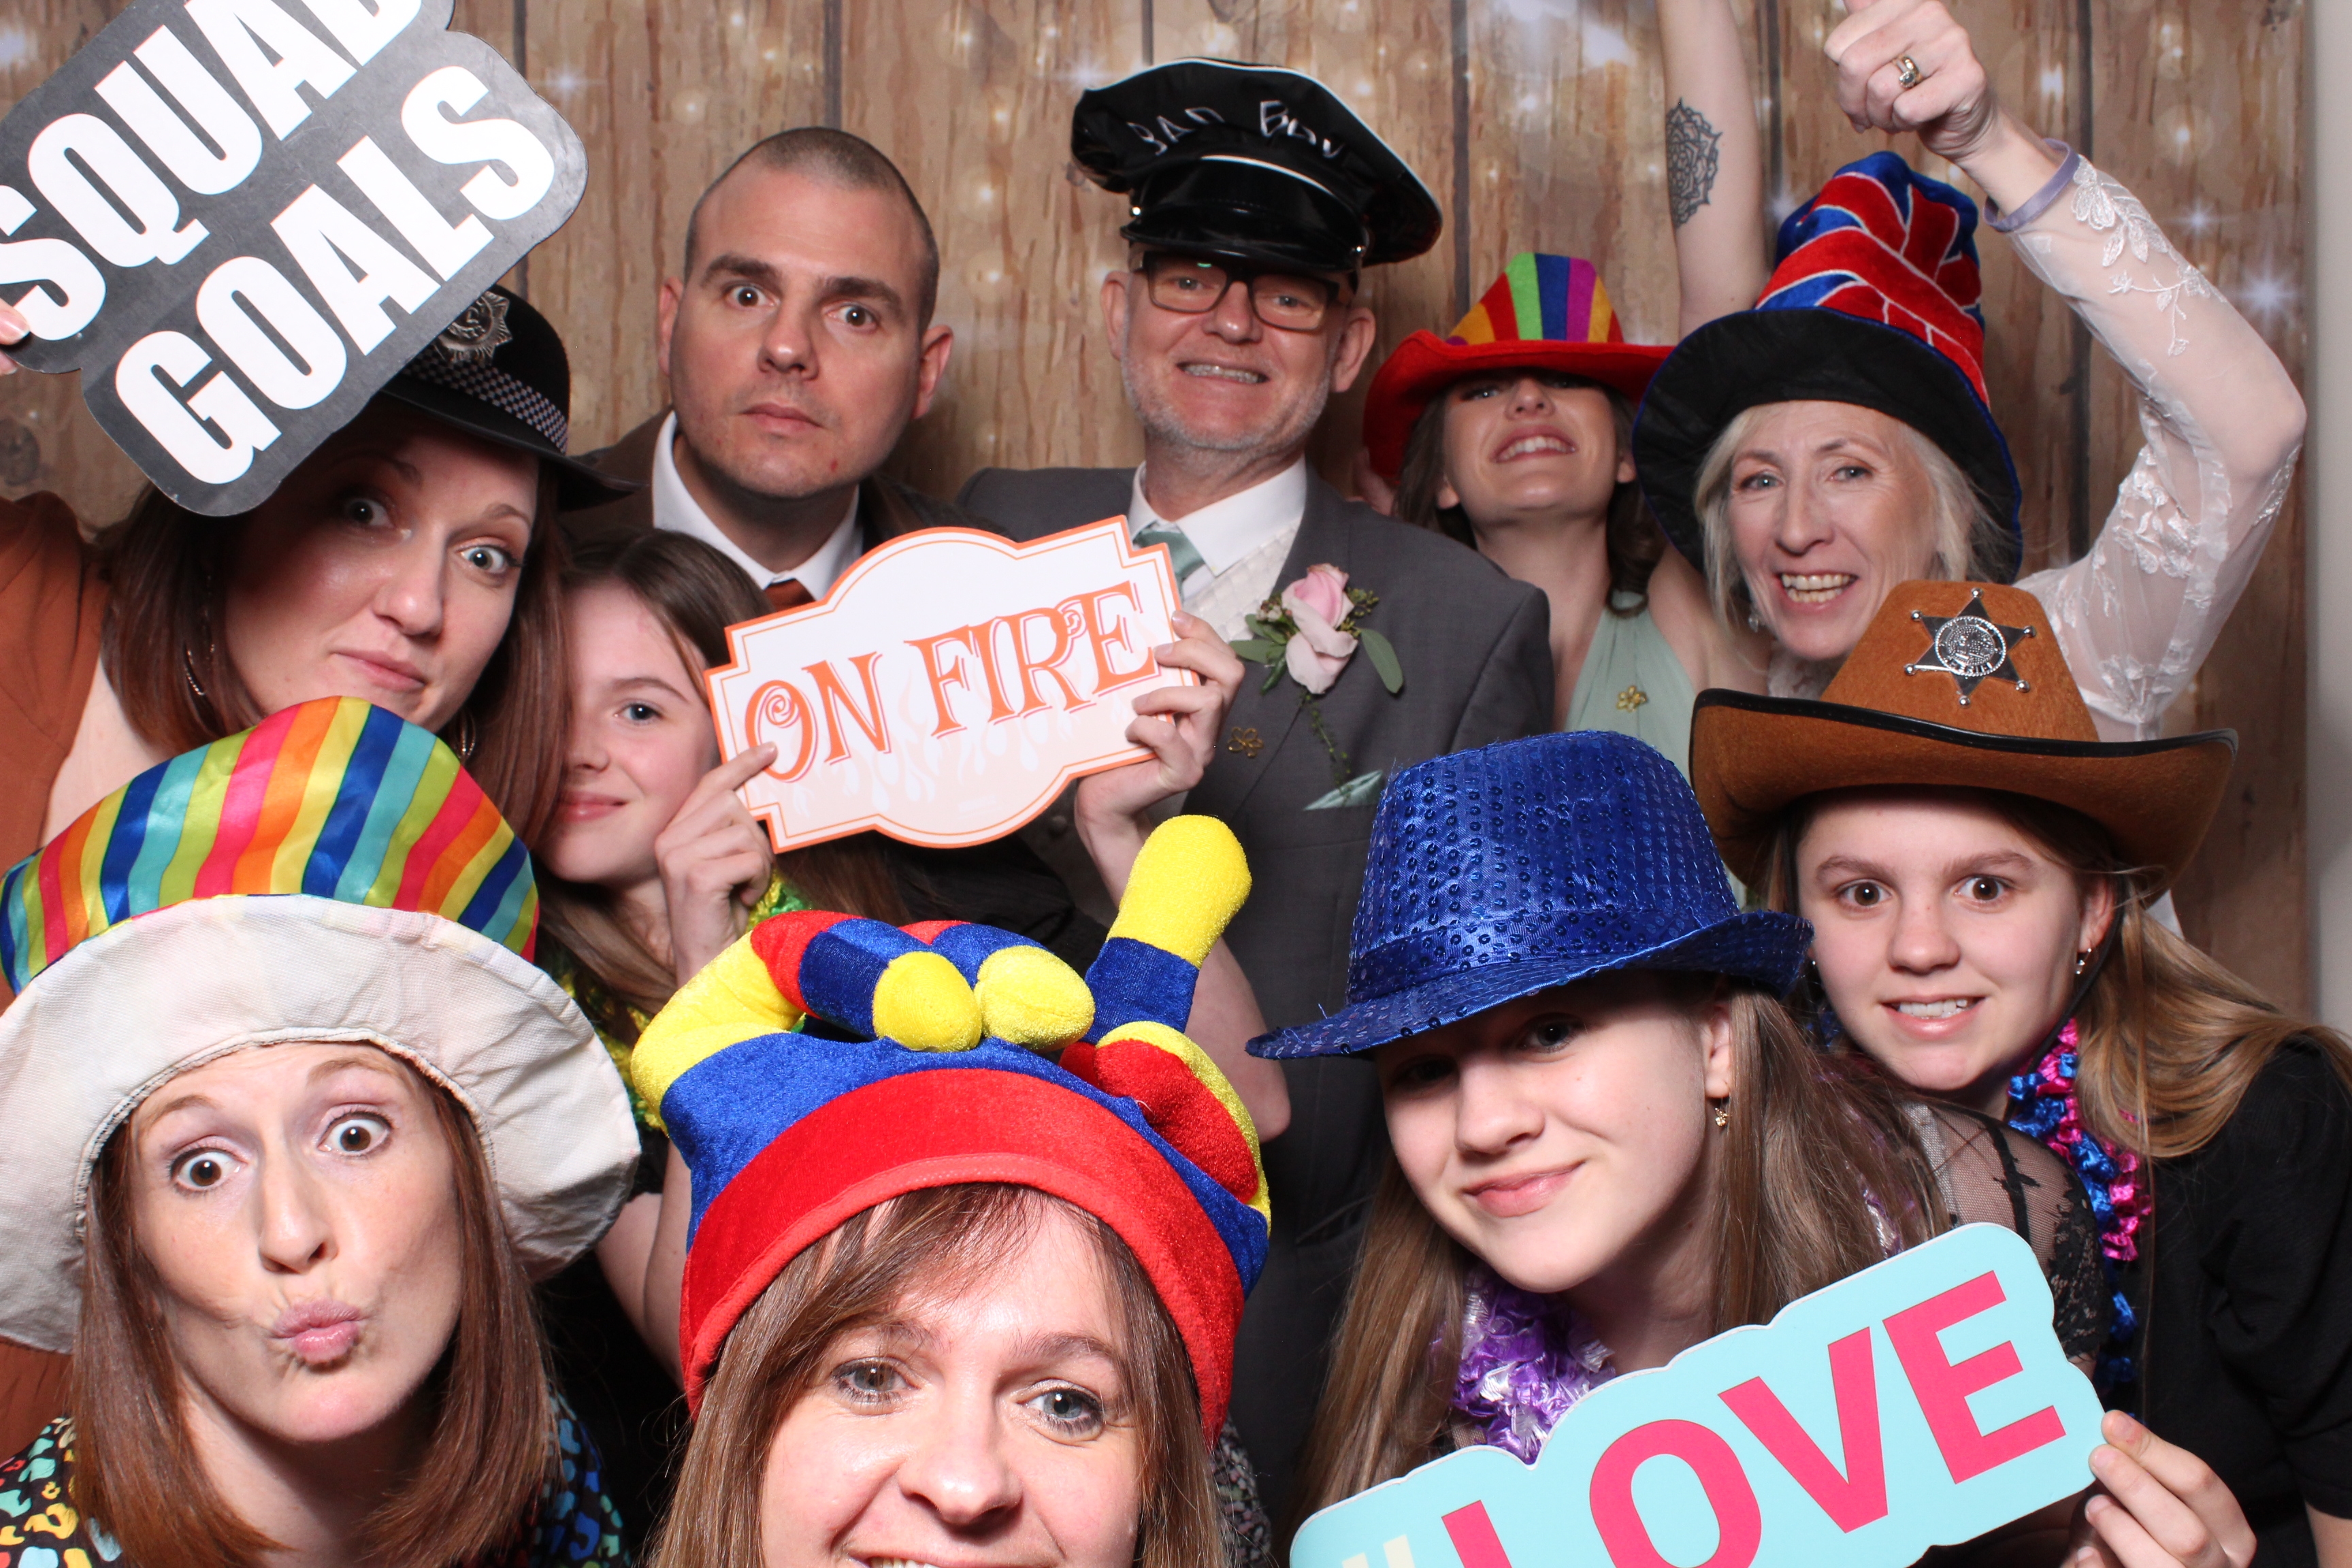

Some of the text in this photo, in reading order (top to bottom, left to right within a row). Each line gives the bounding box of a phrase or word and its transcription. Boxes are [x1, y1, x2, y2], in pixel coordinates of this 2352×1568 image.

[115, 66, 555, 485] GOALS
[745, 581, 1157, 783] ON FIRE
[1342, 1270, 2066, 1568] OVE
